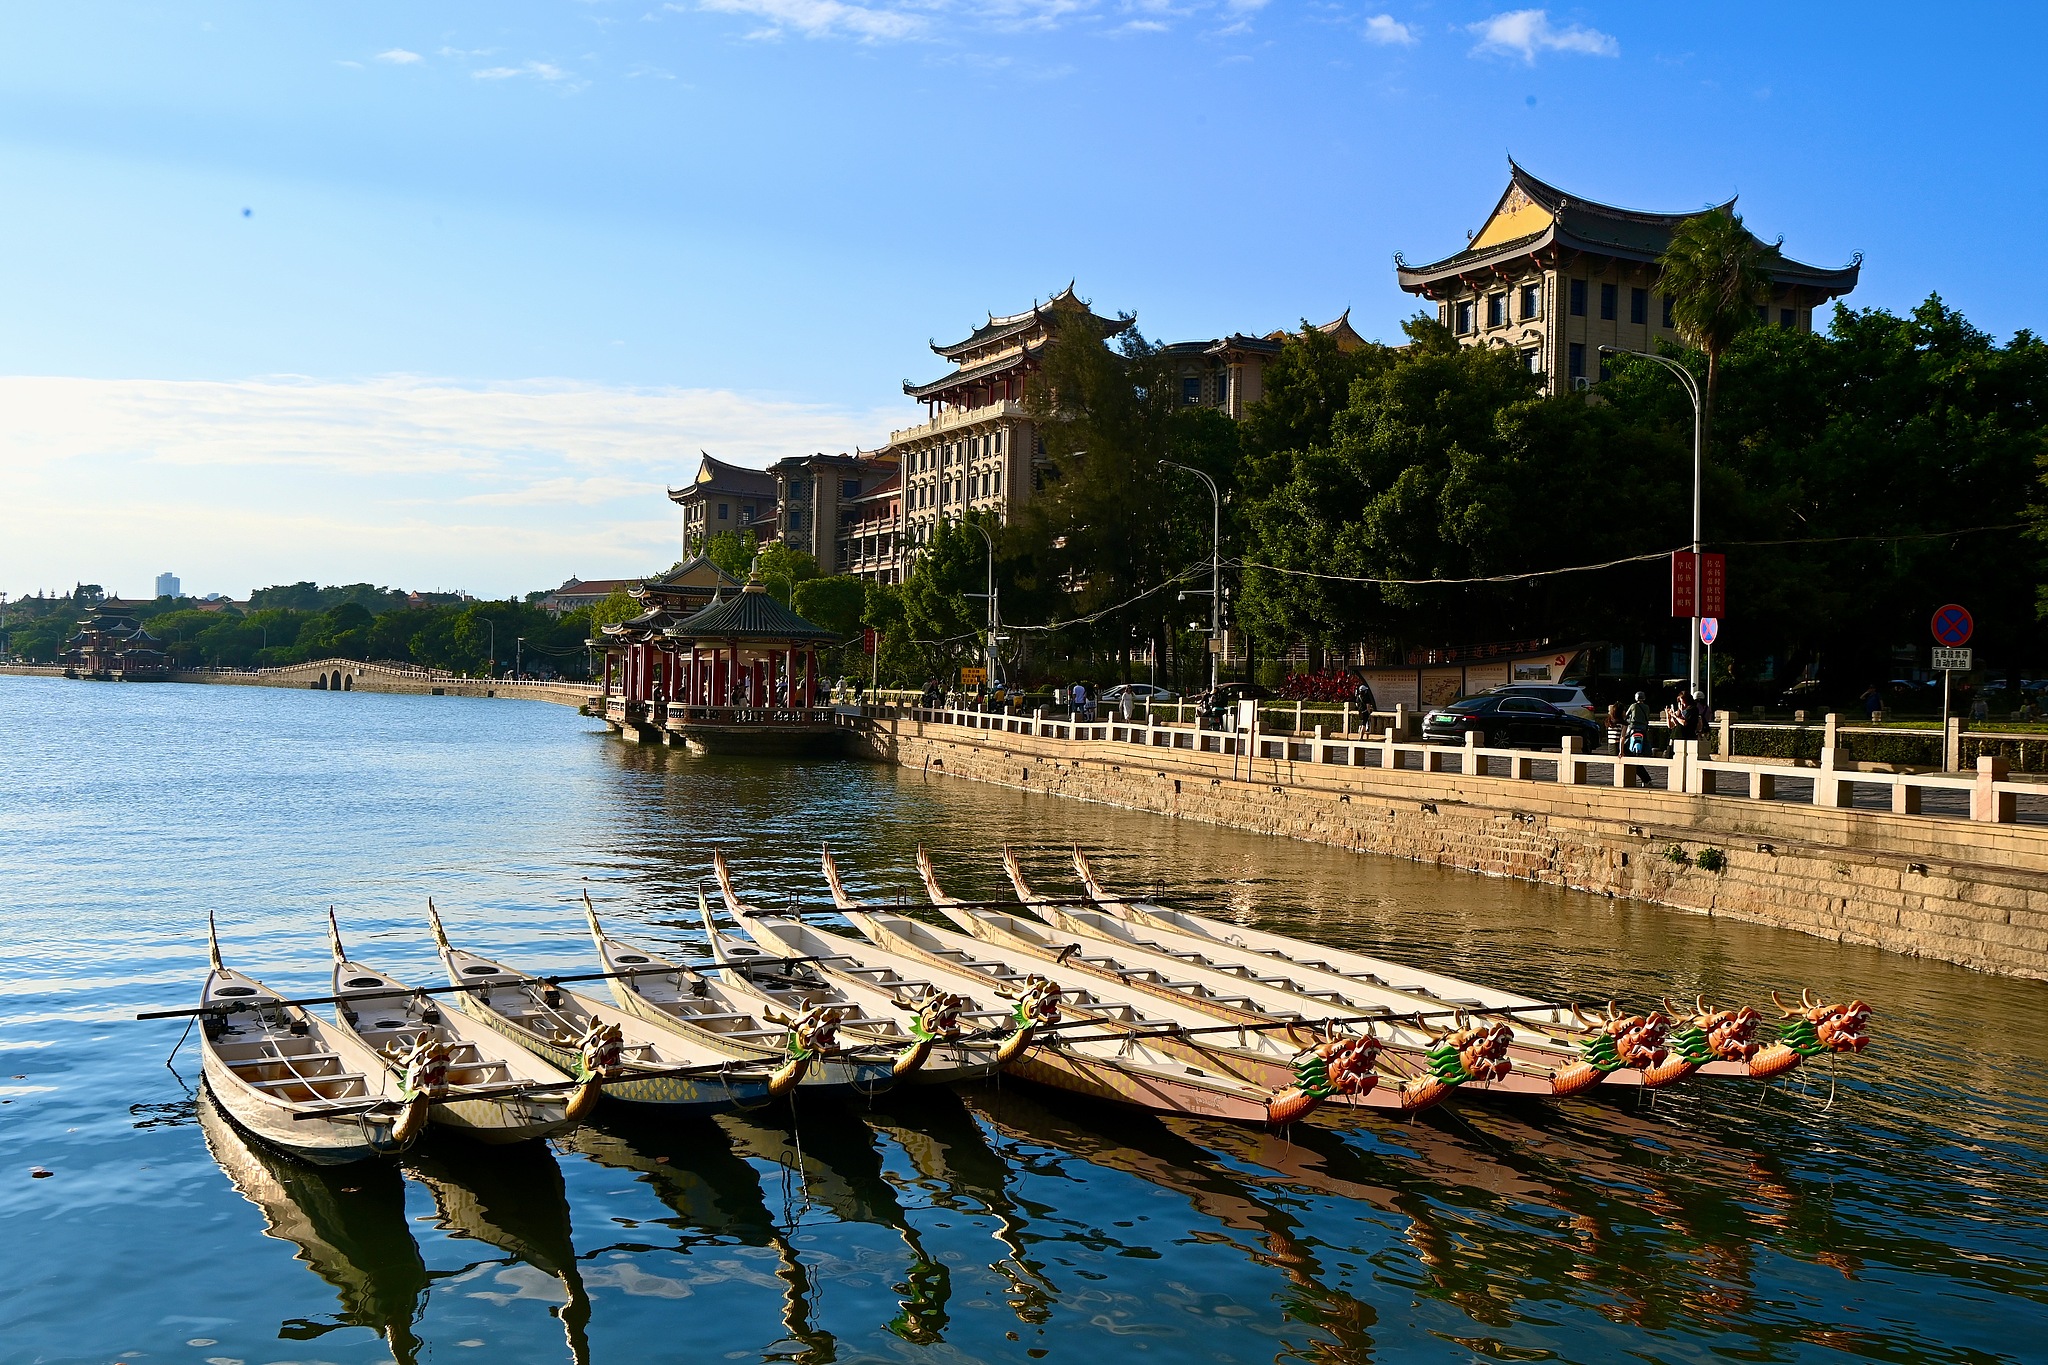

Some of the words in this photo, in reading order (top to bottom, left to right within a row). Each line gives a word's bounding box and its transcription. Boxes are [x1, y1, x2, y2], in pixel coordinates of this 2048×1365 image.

[1934, 650, 1968, 659] 全路段禁停
[1935, 659, 1966, 667] 自动抓拍
